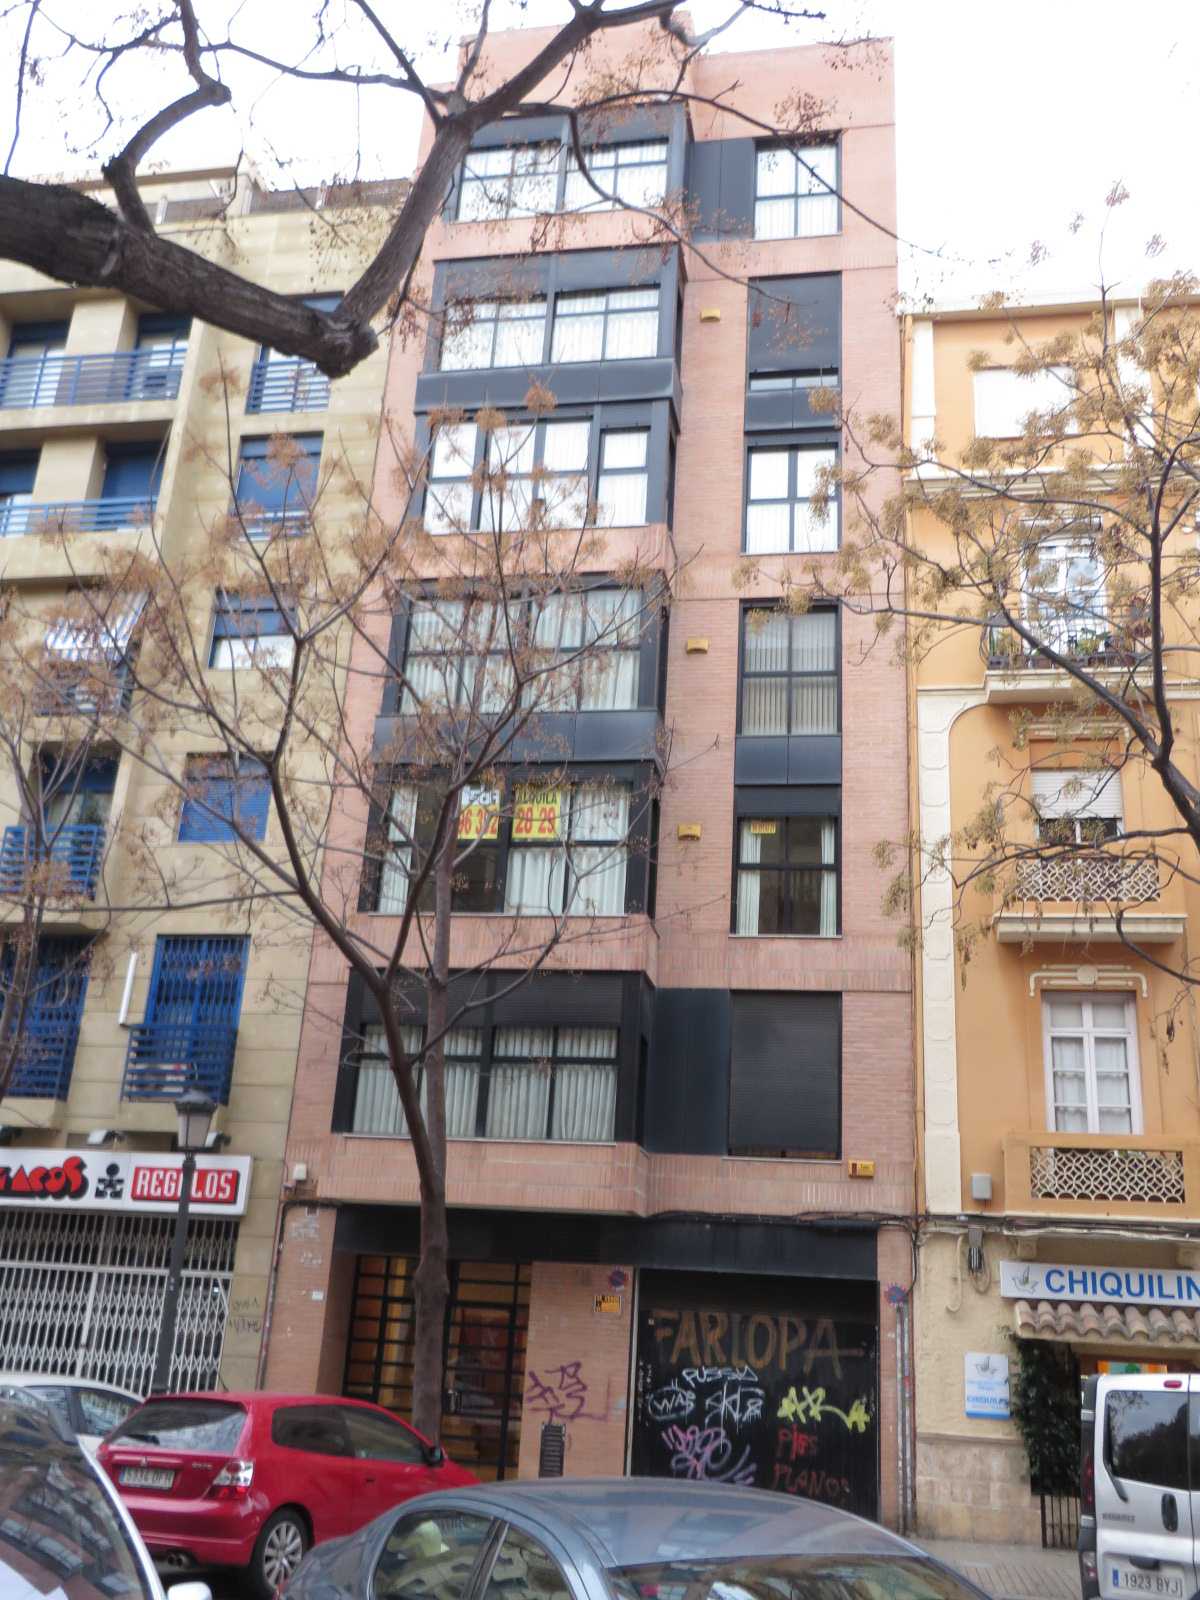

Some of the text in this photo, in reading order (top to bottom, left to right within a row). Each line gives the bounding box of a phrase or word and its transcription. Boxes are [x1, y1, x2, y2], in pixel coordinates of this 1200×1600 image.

[514, 806, 557, 834] 28 29
[136, 1169, 233, 1200] REGLOS
[653, 1310, 864, 1380] FARLOPA
[1124, 1571, 1152, 1590] 1923
